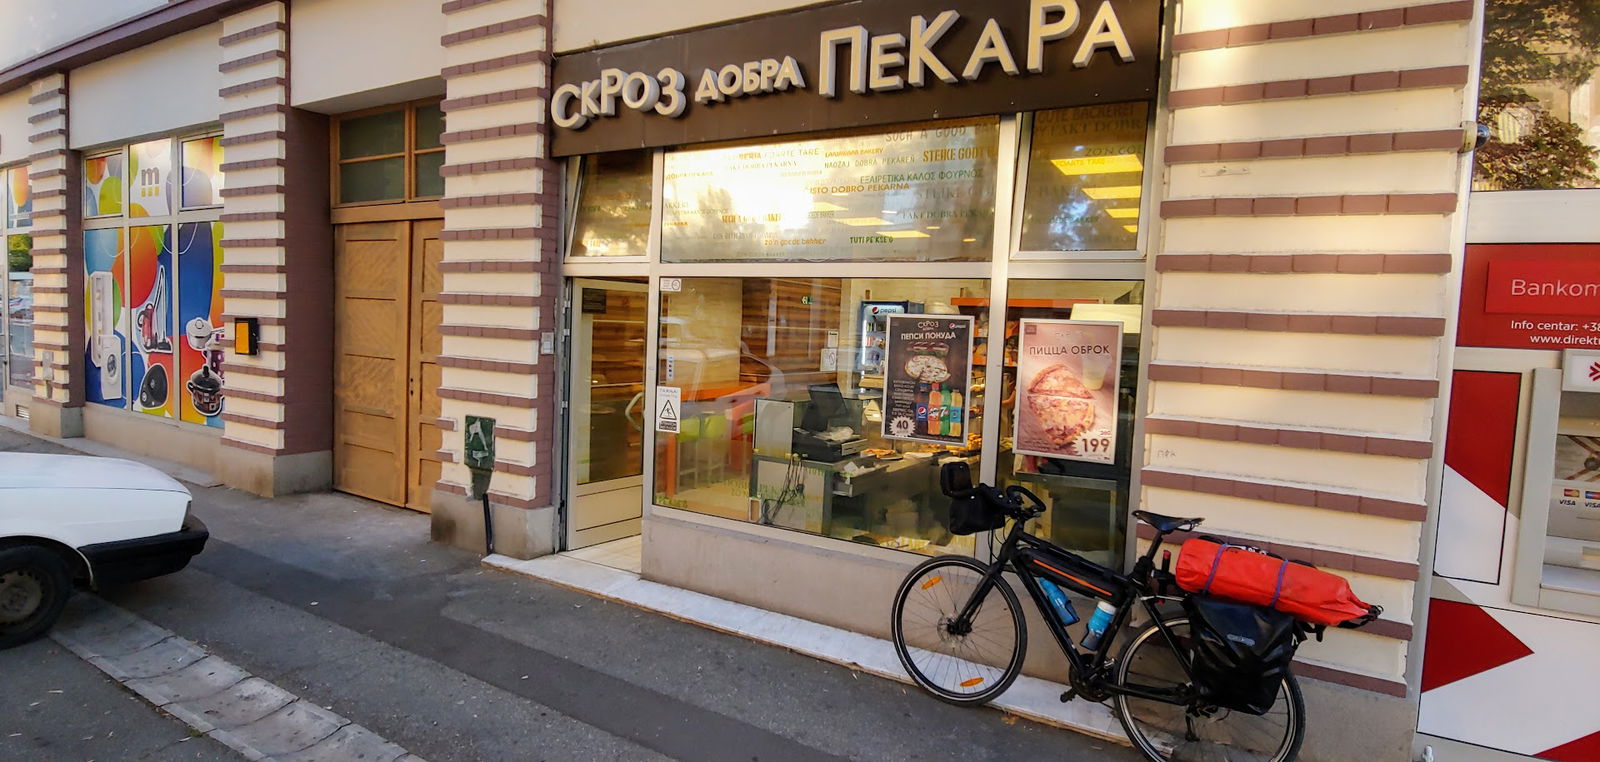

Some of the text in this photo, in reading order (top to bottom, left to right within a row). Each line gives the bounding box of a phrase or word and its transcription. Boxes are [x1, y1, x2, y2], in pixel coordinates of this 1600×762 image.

[551, 67, 686, 129] СКРОЗ
[695, 55, 806, 104] ДОБРА
[831, 185, 865, 194] DOBRO
[867, 182, 910, 192] PEKARNA
[1511, 319, 1534, 330] Info
[1537, 321, 1579, 331] centar:
[901, 331, 957, 340] ПЕПСИ ПОНУДА
[1530, 335, 1600, 346] www.direkt
[1029, 345, 1111, 356] ПИЦЦА ОБРОК
[896, 420, 909, 430] 40
[1082, 438, 1110, 453] 199
